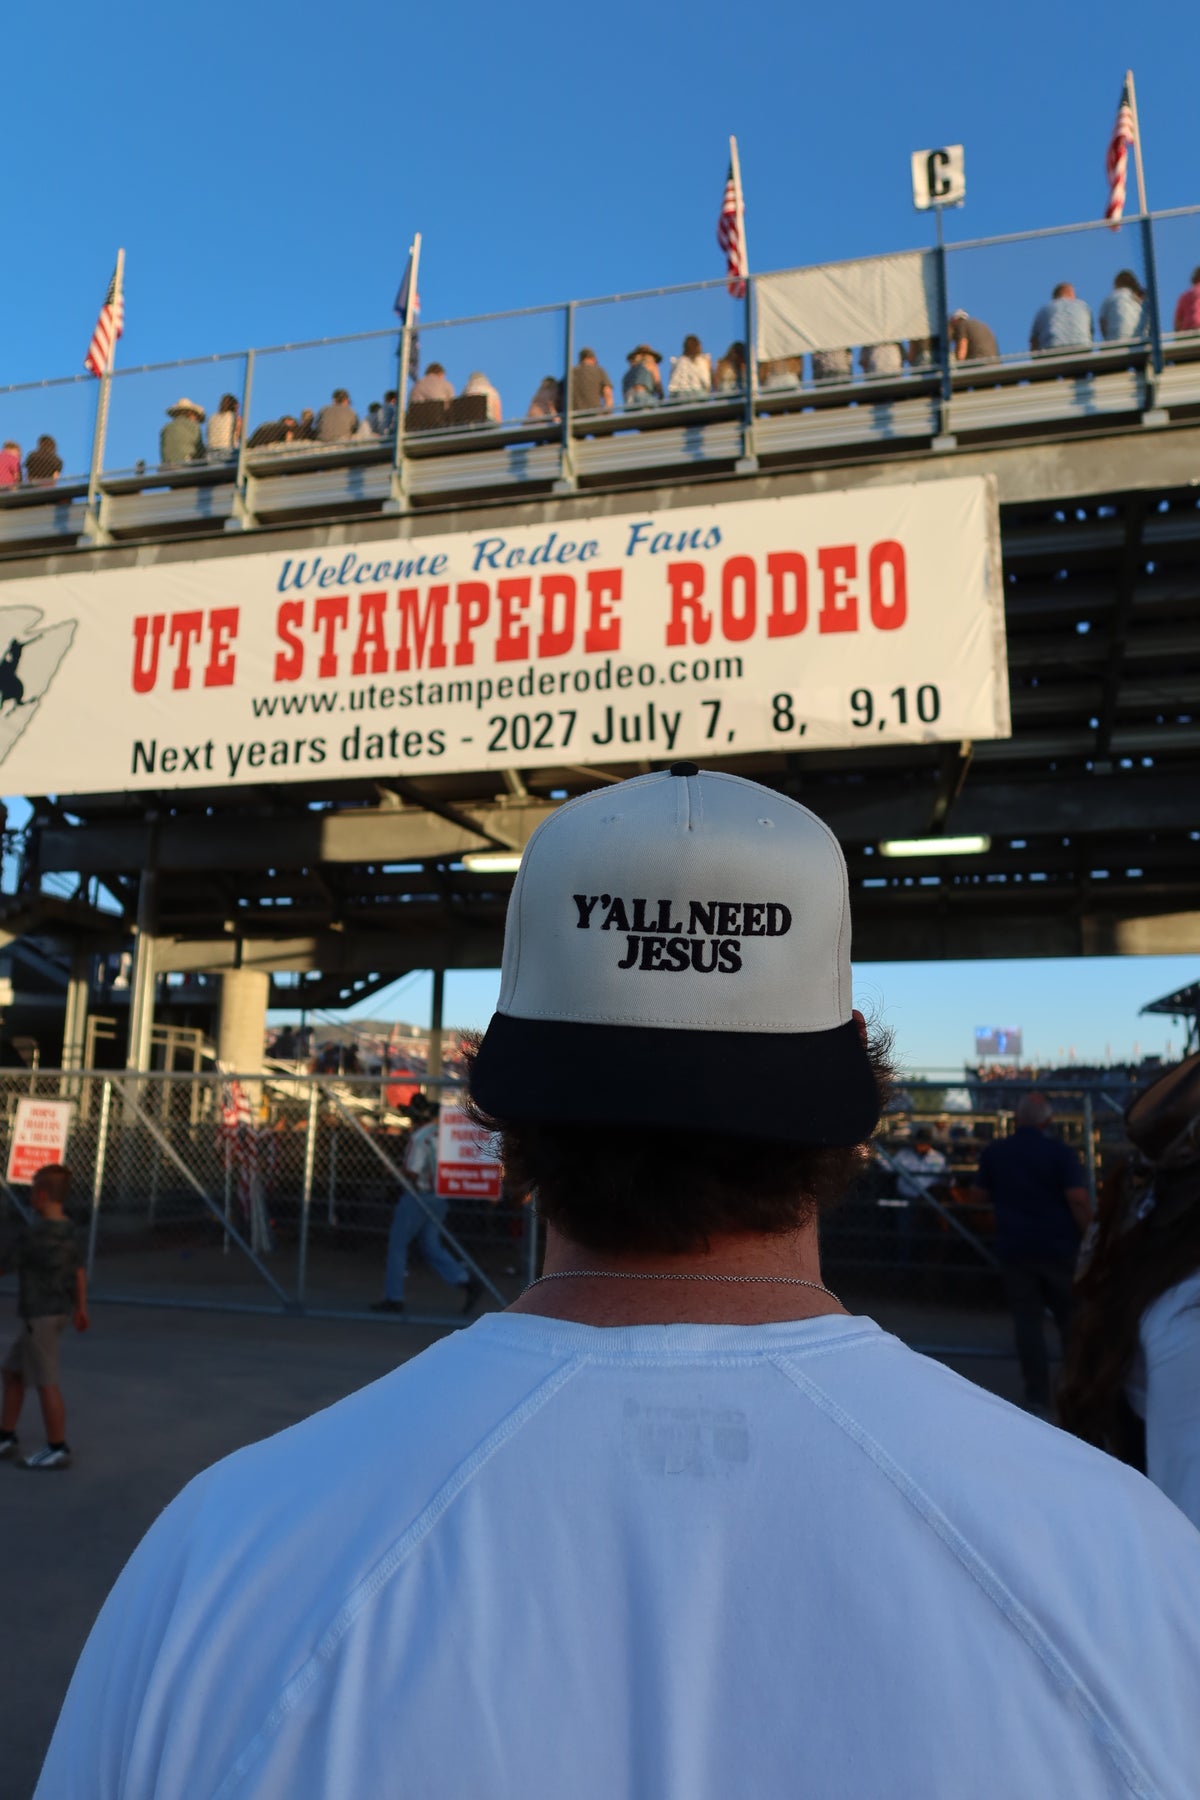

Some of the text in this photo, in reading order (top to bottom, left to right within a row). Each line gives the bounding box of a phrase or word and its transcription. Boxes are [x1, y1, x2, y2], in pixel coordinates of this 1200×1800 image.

[927, 151, 951, 197] C
[277, 521, 722, 593] Welcome Rodeo Fans
[132, 539, 908, 694] UTE STAMPEDE RODEO
[252, 657, 744, 718] www.utestampederodeo.com
[132, 739, 215, 774] Next
[227, 736, 328, 777] years
[341, 725, 446, 761] dates
[487, 709, 578, 752] 2027
[592, 702, 682, 751] July
[701, 699, 736, 742] 7,
[771, 692, 808, 736] 8,
[573, 893, 793, 937] Y'ALL NEED
[617, 934, 743, 974] JESUS
